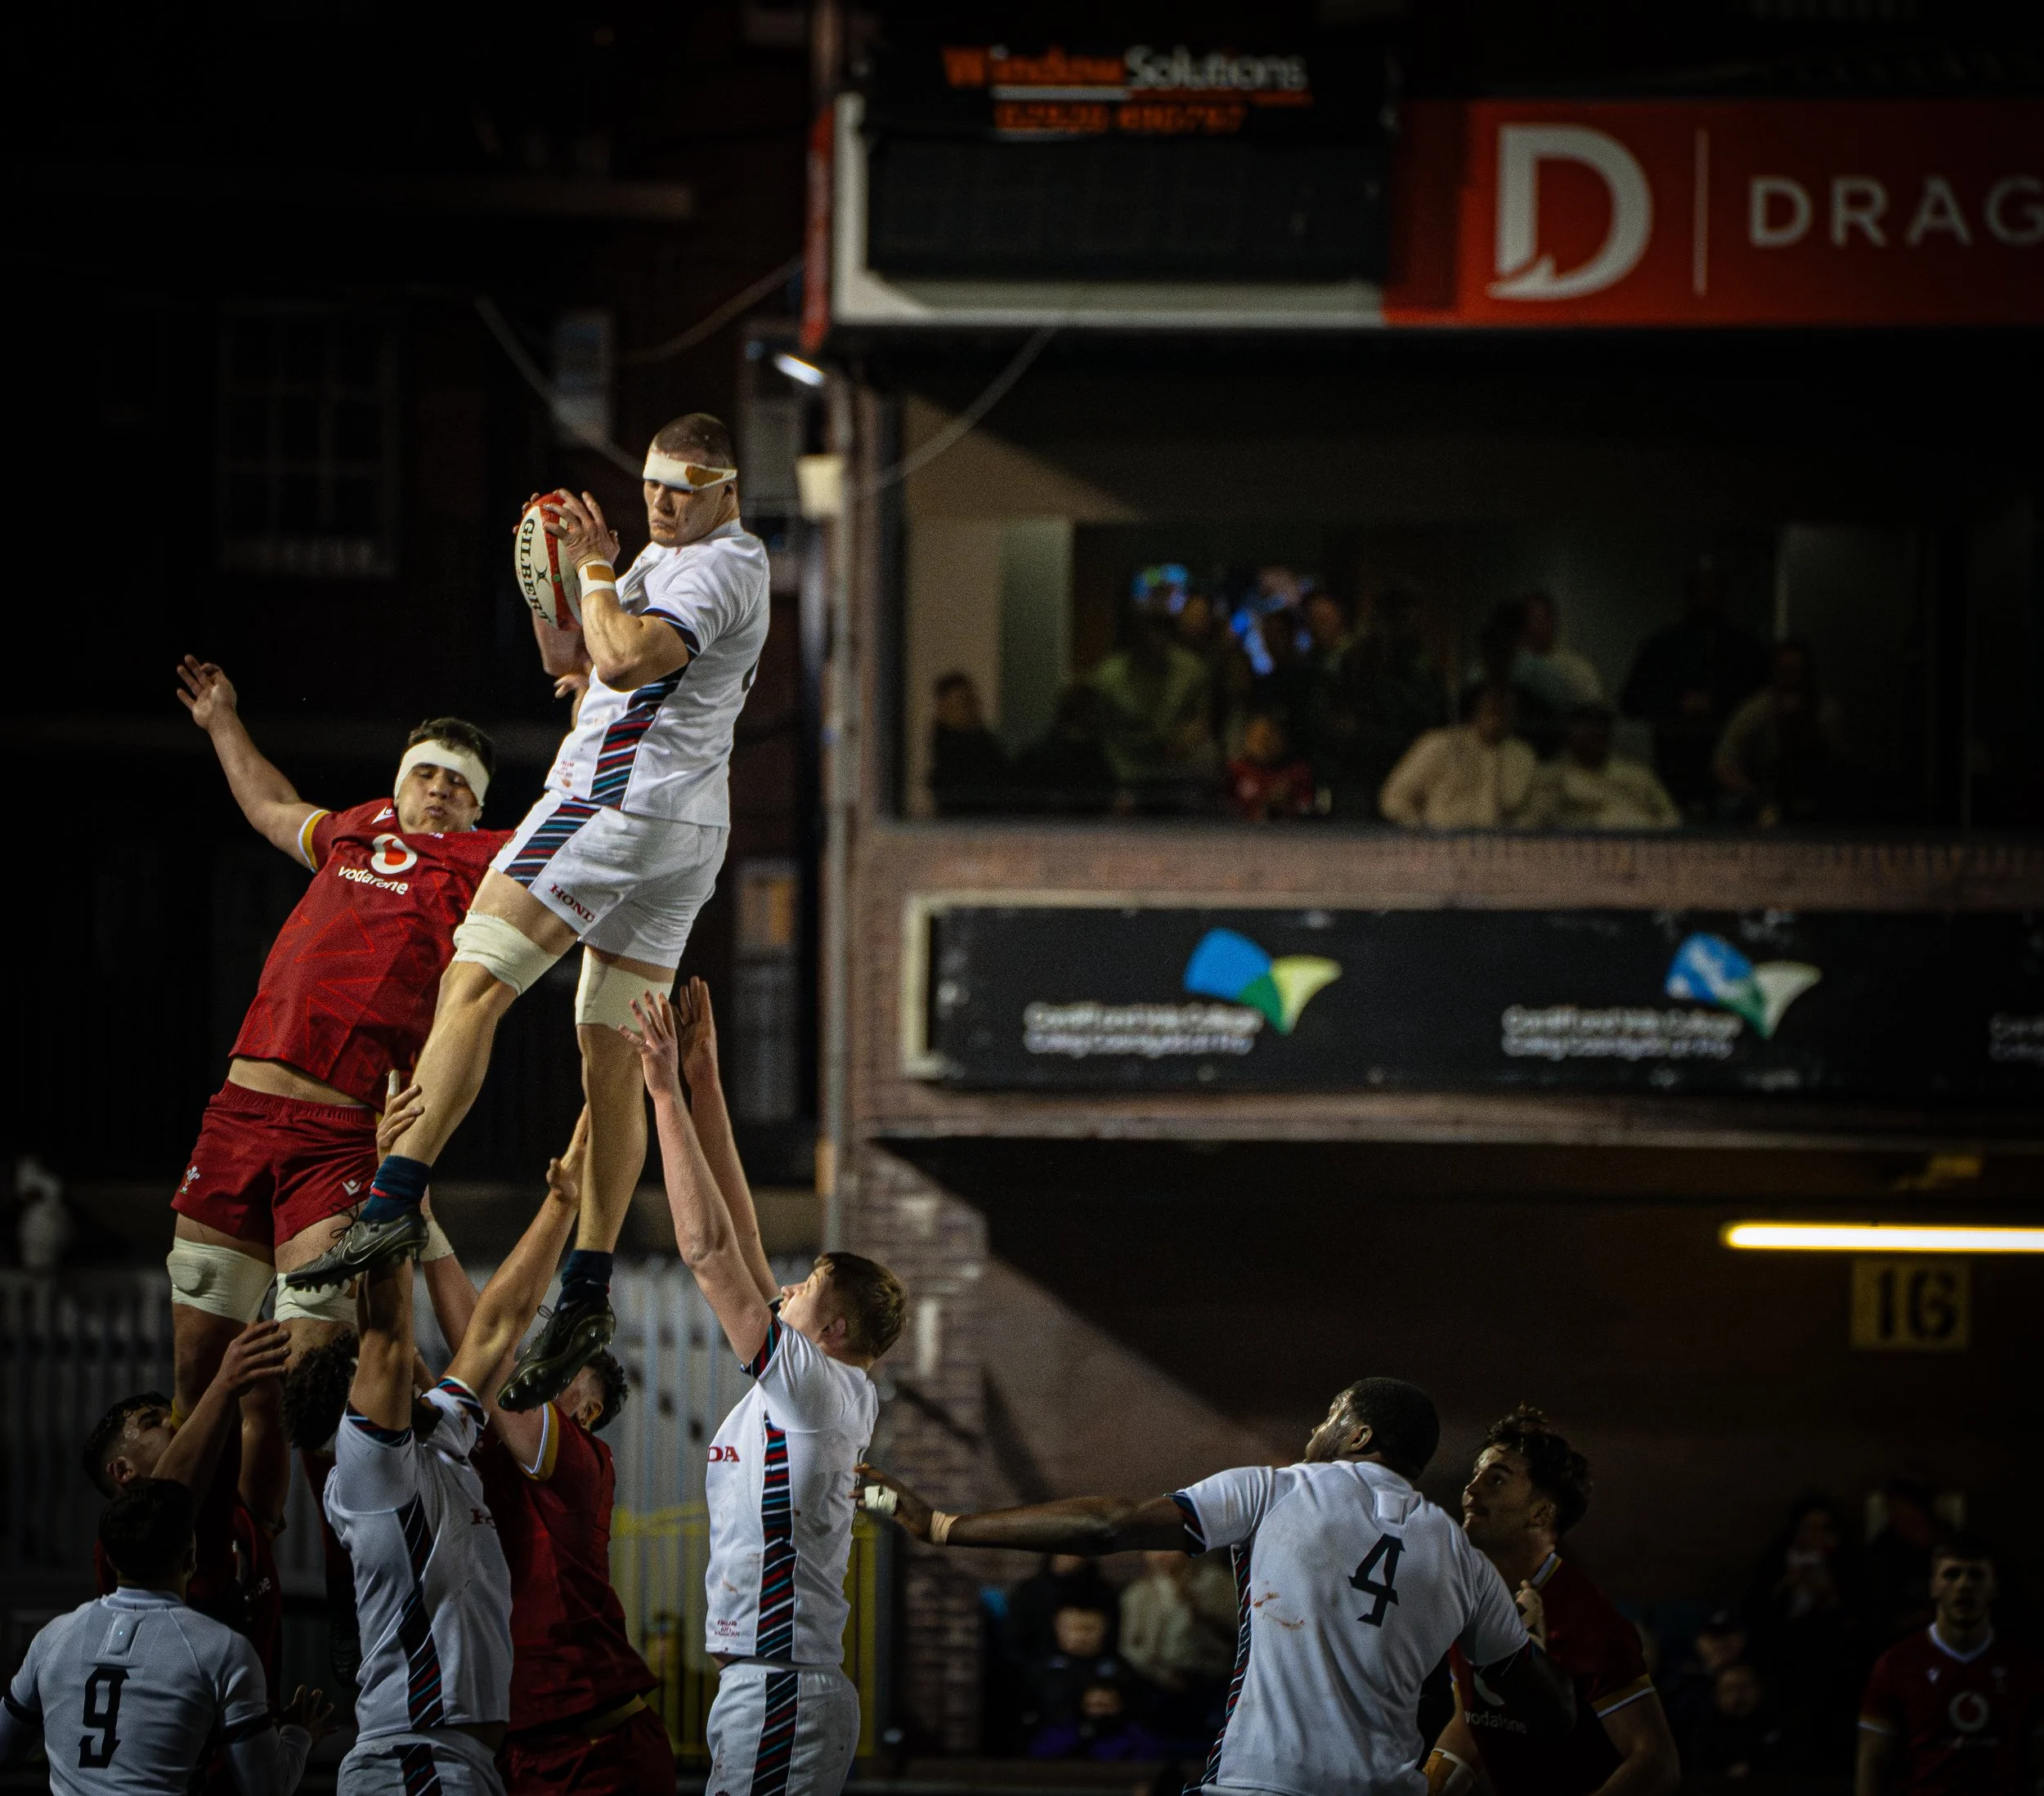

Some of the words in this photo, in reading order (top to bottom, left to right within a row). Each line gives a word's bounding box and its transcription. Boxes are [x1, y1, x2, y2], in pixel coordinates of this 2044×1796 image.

[1486, 122, 1655, 302] D
[1746, 173, 2044, 249] DRAG
[1880, 1270, 1956, 1338] 16
[1347, 1533, 1405, 1628] 4
[78, 1664, 130, 1768] 9
